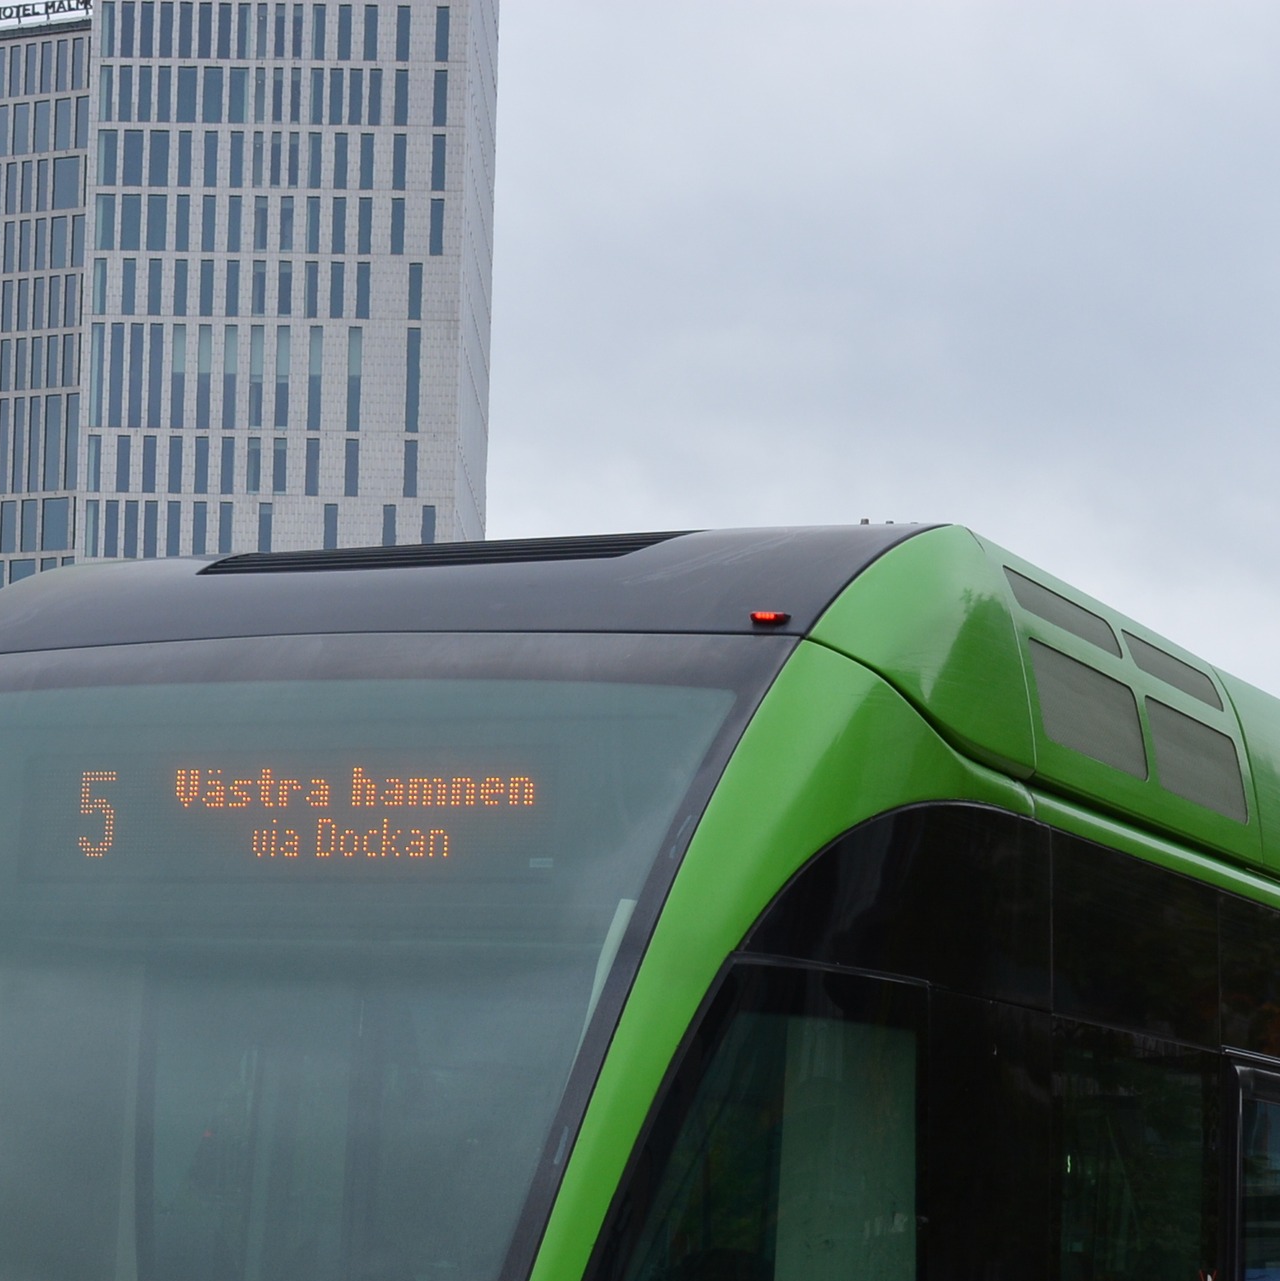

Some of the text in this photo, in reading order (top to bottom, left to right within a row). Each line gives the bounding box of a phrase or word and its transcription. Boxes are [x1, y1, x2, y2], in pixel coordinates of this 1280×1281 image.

[175, 766, 535, 808] Västra hamnen
[78, 770, 117, 858] 5
[252, 817, 450, 858] via Dockan
